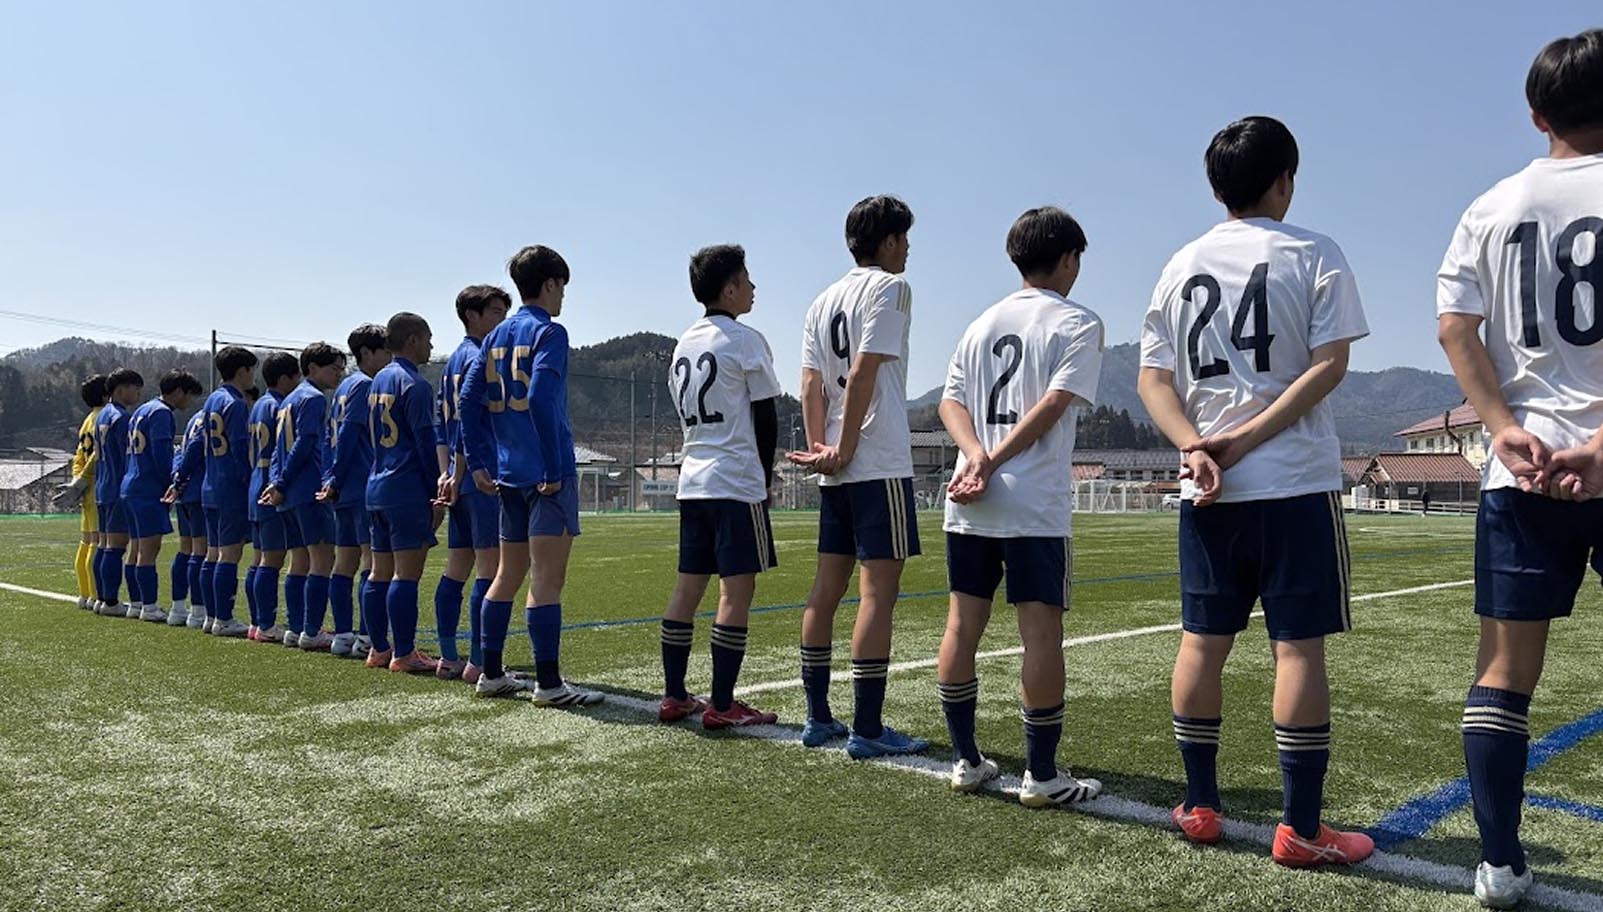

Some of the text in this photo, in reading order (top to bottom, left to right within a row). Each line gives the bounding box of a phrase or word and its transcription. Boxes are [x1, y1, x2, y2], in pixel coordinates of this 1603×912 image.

[1181, 262, 1275, 380] 24
[1504, 216, 1603, 347] 18
[486, 345, 532, 413] 55
[675, 352, 724, 427] 22
[831, 311, 850, 389] 9
[987, 334, 1023, 424] 2
